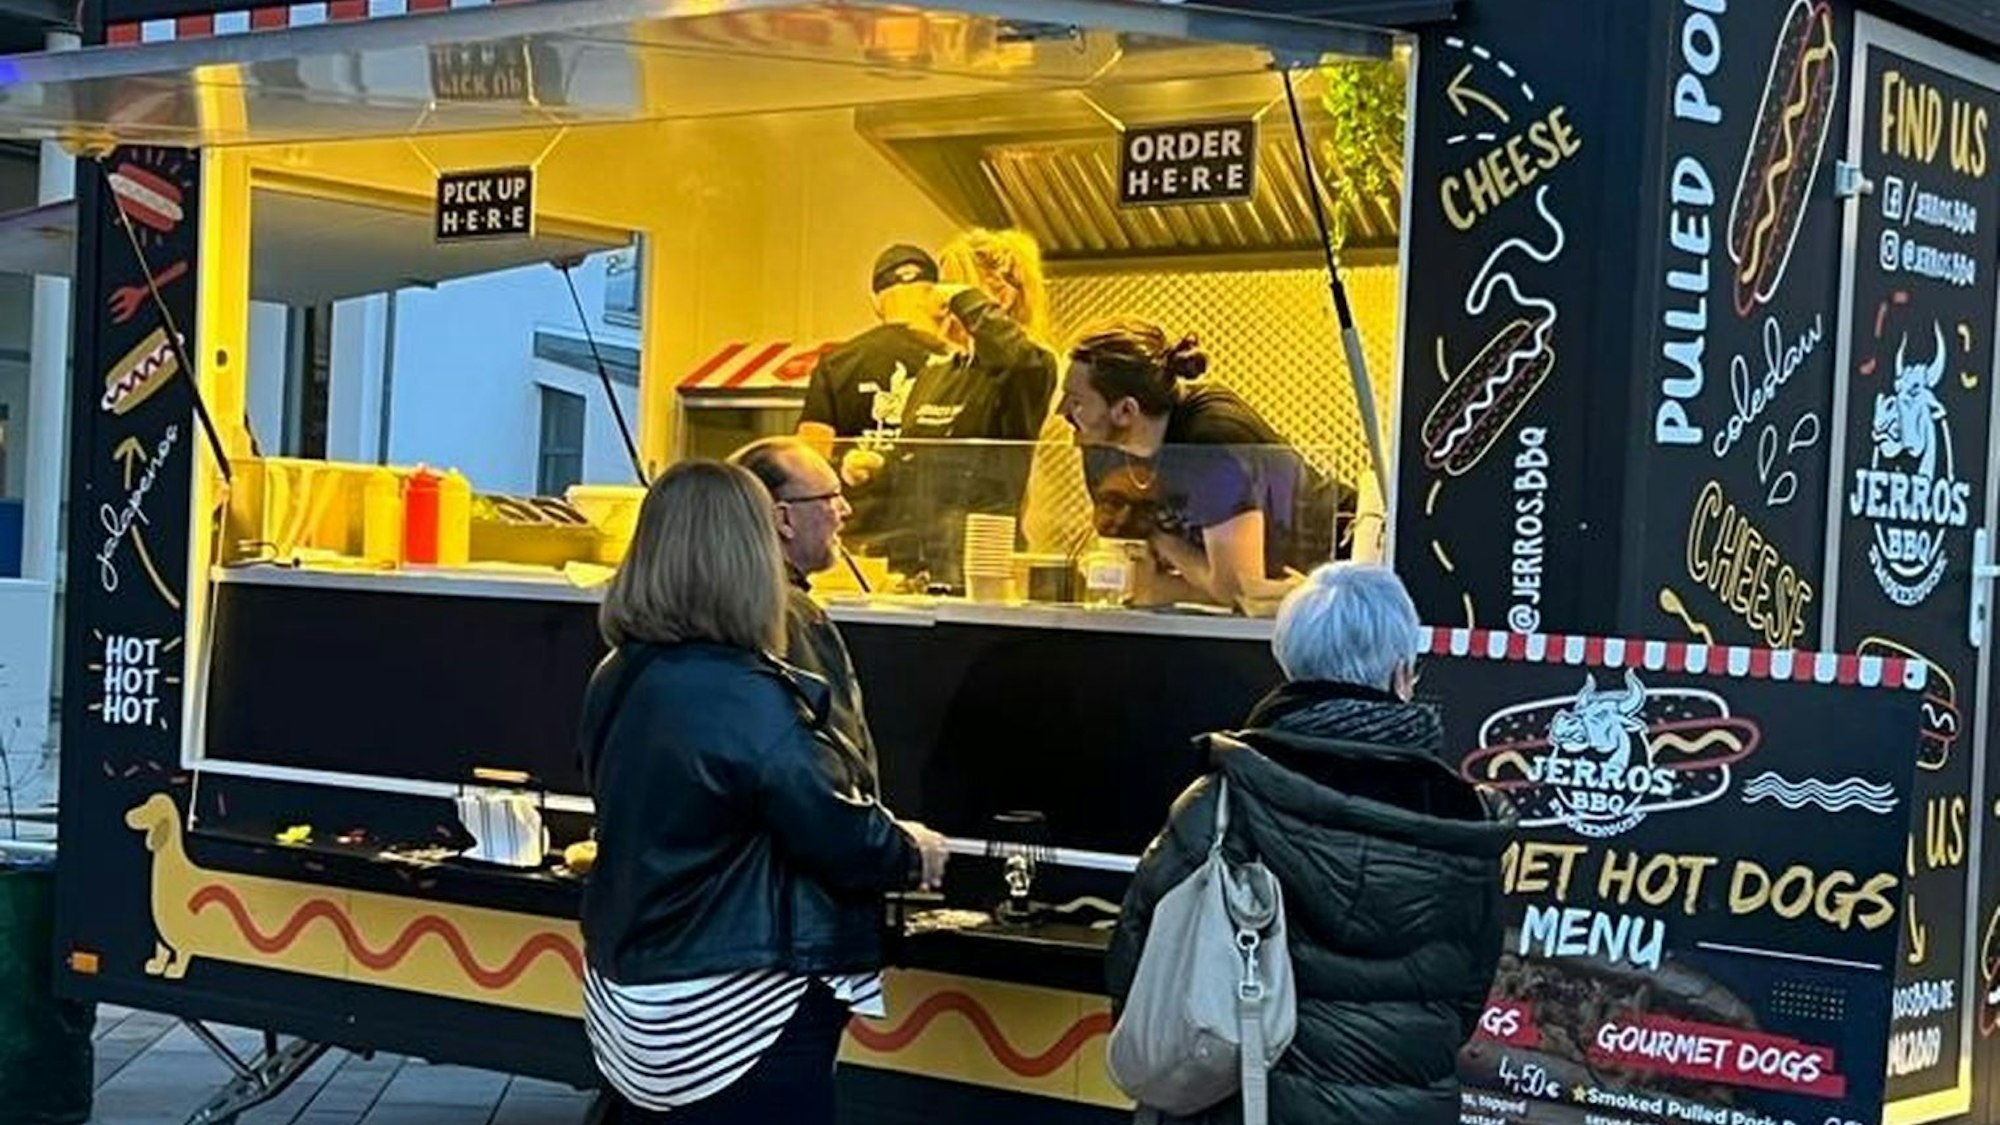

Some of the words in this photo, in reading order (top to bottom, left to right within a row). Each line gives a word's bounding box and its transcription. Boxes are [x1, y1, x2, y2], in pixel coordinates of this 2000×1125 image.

[1674, 0, 1727, 124] PO
[1130, 129, 1243, 163] ORDER
[1881, 71, 1943, 164] FIND
[1951, 100, 1988, 178] US
[443, 180, 492, 205] PICK
[497, 177, 527, 200] UP
[1441, 106, 1582, 230] CHEESE
[1656, 156, 1715, 443] PULLED
[1713, 313, 1822, 457] coleslaw
[1850, 468, 1970, 526] JERROS
[1508, 426, 1549, 634] @JERROS.BBQ
[1888, 528, 1931, 566] BBQ
[1687, 480, 1813, 647] CHEESE
[104, 665, 160, 695] HOT
[105, 635, 161, 666] HOT
[103, 694, 160, 725] HOT
[1526, 756, 1677, 796] JERROS
[1571, 790, 1627, 817] BBQ
[1925, 797, 1964, 869] US
[1598, 848, 1717, 916] HOT
[1728, 859, 1898, 930] DOGS
[1519, 904, 1665, 971] MENU
[1597, 1023, 1732, 1069] GOURMET
[1737, 1043, 1822, 1083] DOGS
[1587, 1086, 1663, 1114] Smoked
[1667, 1101, 1728, 1125] Pulled
